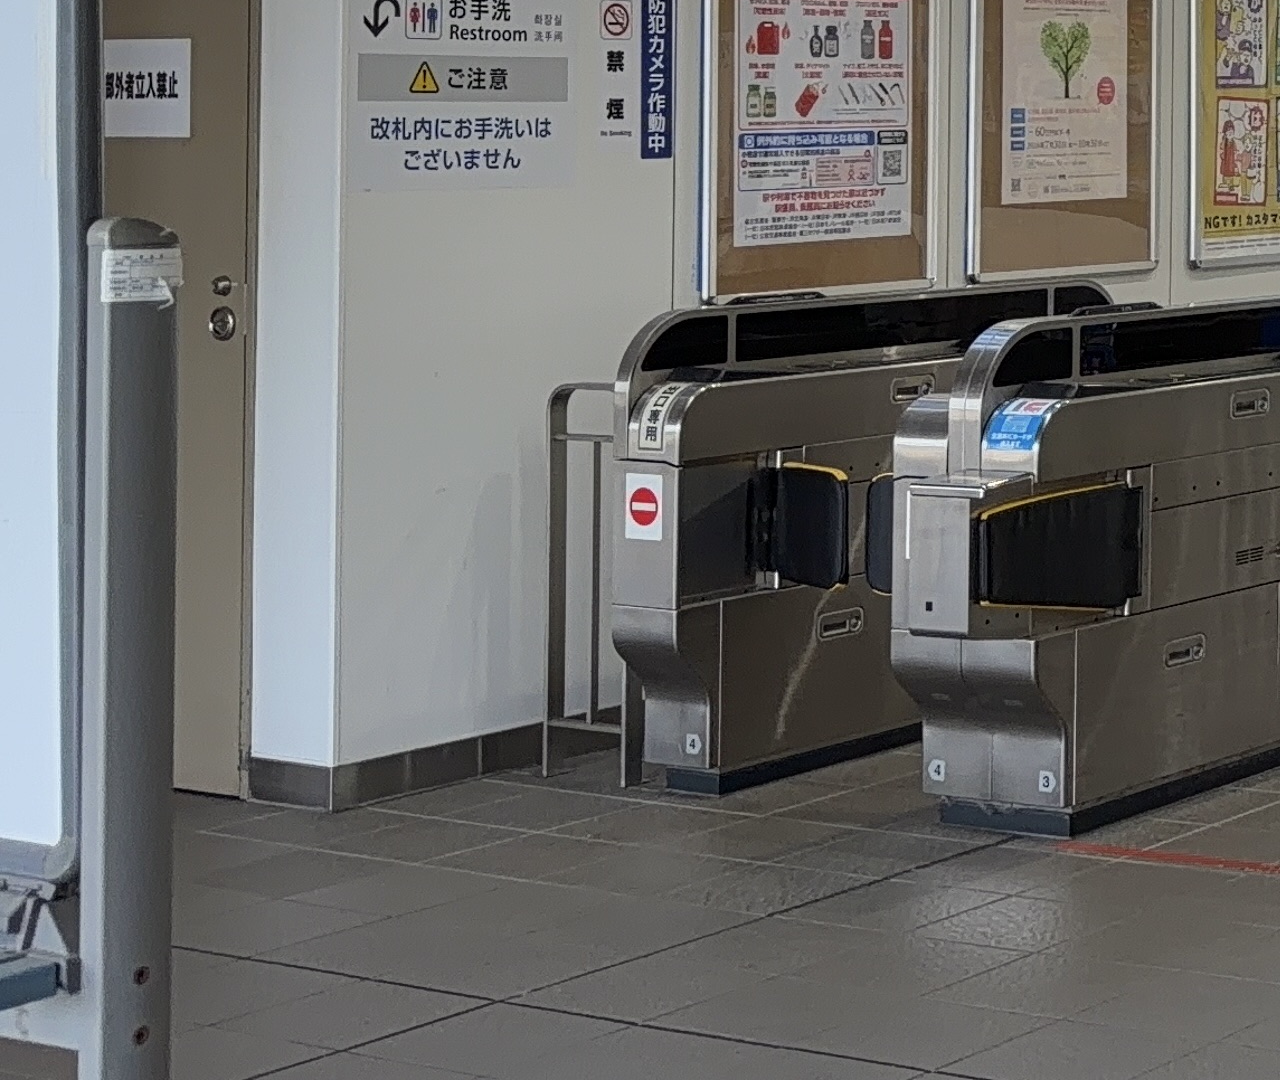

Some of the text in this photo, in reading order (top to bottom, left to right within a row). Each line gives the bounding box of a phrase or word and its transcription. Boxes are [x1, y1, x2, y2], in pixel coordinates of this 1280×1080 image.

[450, 24, 528, 42] Restroom
[105, 71, 178, 100] 部外者立入禁止
[448, 67, 508, 91] ご注意
[370, 117, 552, 140] 改札内にお手洗いは
[404, 148, 521, 170] ございません
[689, 738, 696, 750] 4
[934, 764, 941, 776] 4
[1042, 775, 1050, 788] 3
